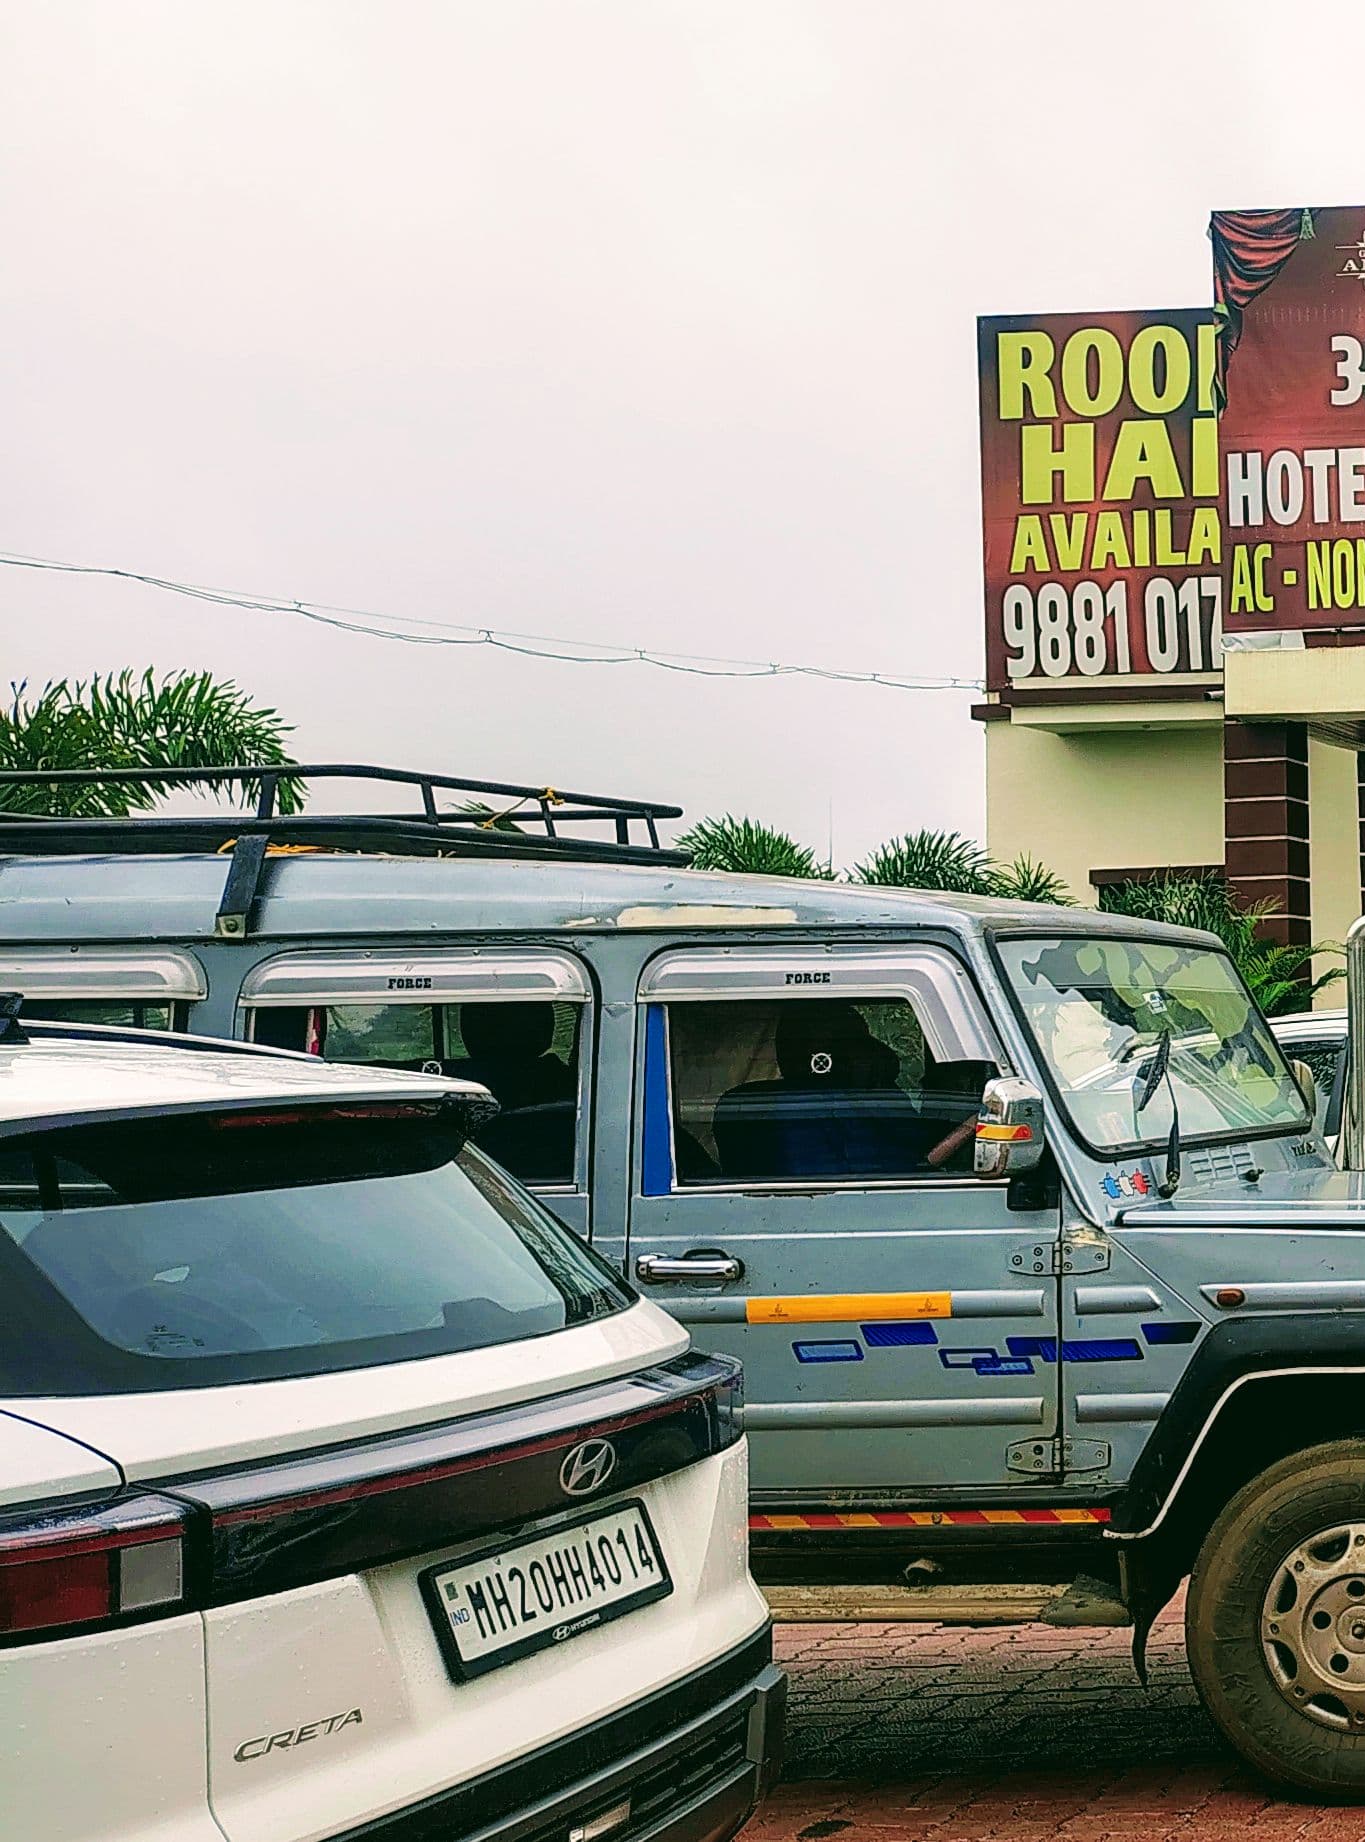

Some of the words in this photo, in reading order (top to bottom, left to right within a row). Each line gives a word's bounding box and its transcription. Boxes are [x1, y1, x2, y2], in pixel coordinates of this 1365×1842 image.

[1231, 543, 1274, 613] AC
[1003, 580, 1132, 678] 9881
[388, 977, 432, 989] FORCE
[785, 972, 831, 985] FORCE
[465, 1523, 654, 1639] MH20HH4014
[450, 1607, 470, 1626] IND
[233, 1707, 363, 1763] CRETA
